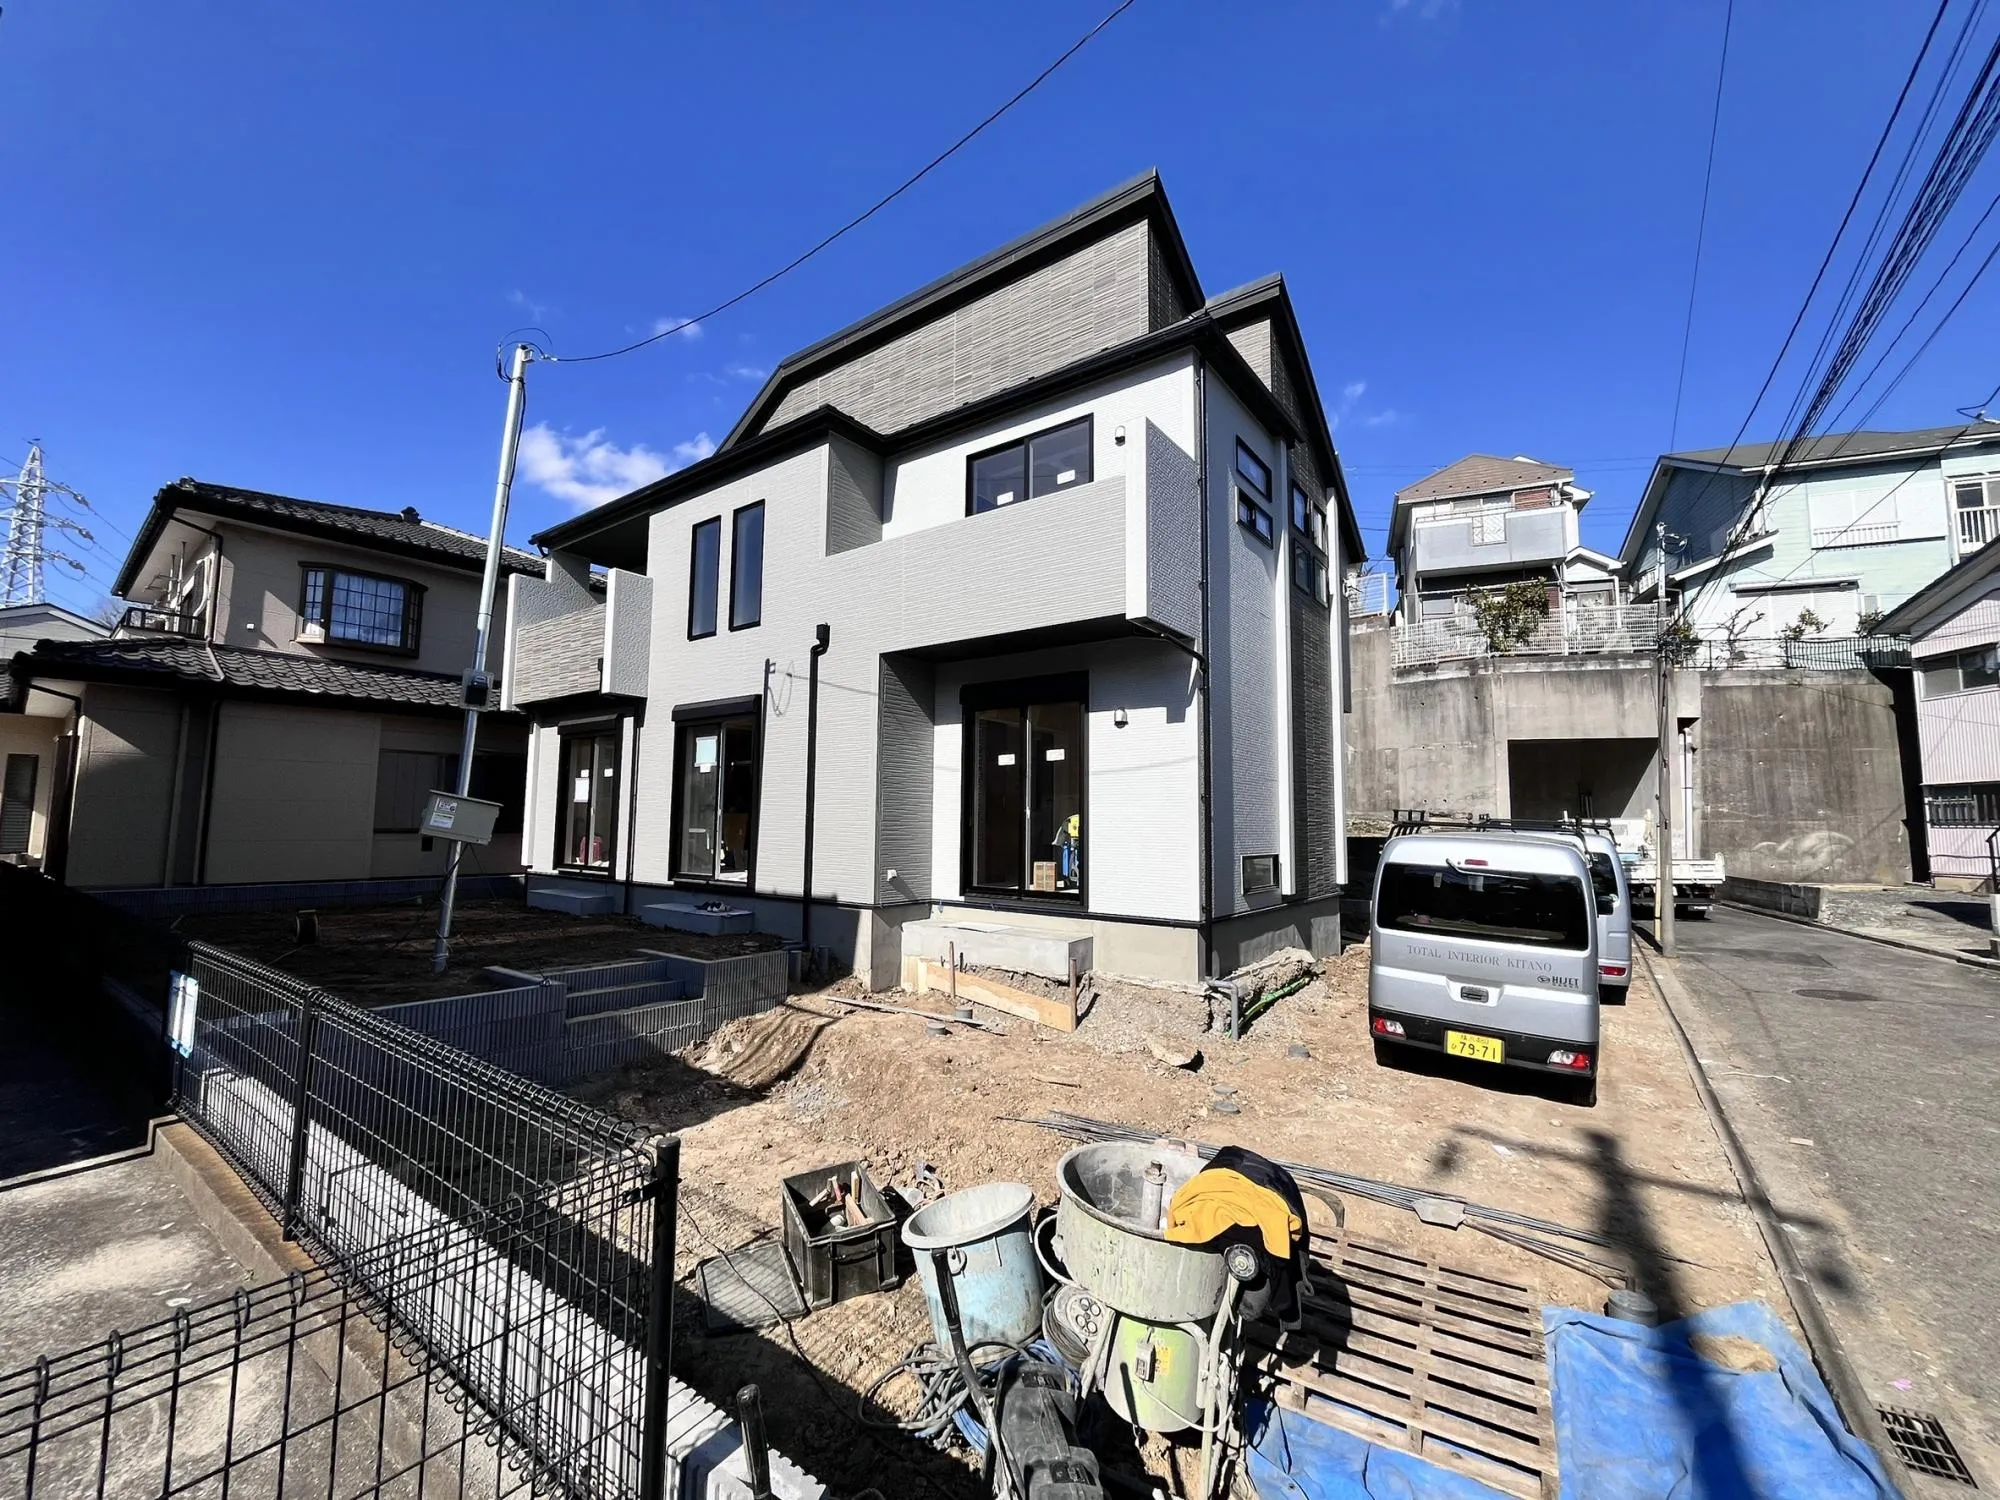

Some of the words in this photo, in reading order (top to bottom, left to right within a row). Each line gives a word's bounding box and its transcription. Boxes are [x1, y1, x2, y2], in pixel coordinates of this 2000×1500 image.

[1406, 944, 1442, 959] TOTAL
[1447, 950, 1500, 967] INTERIOR
[1507, 957, 1552, 972] KITANO
[1551, 975, 1580, 987] HIJET
[1459, 1041, 1497, 1060] 79-71
